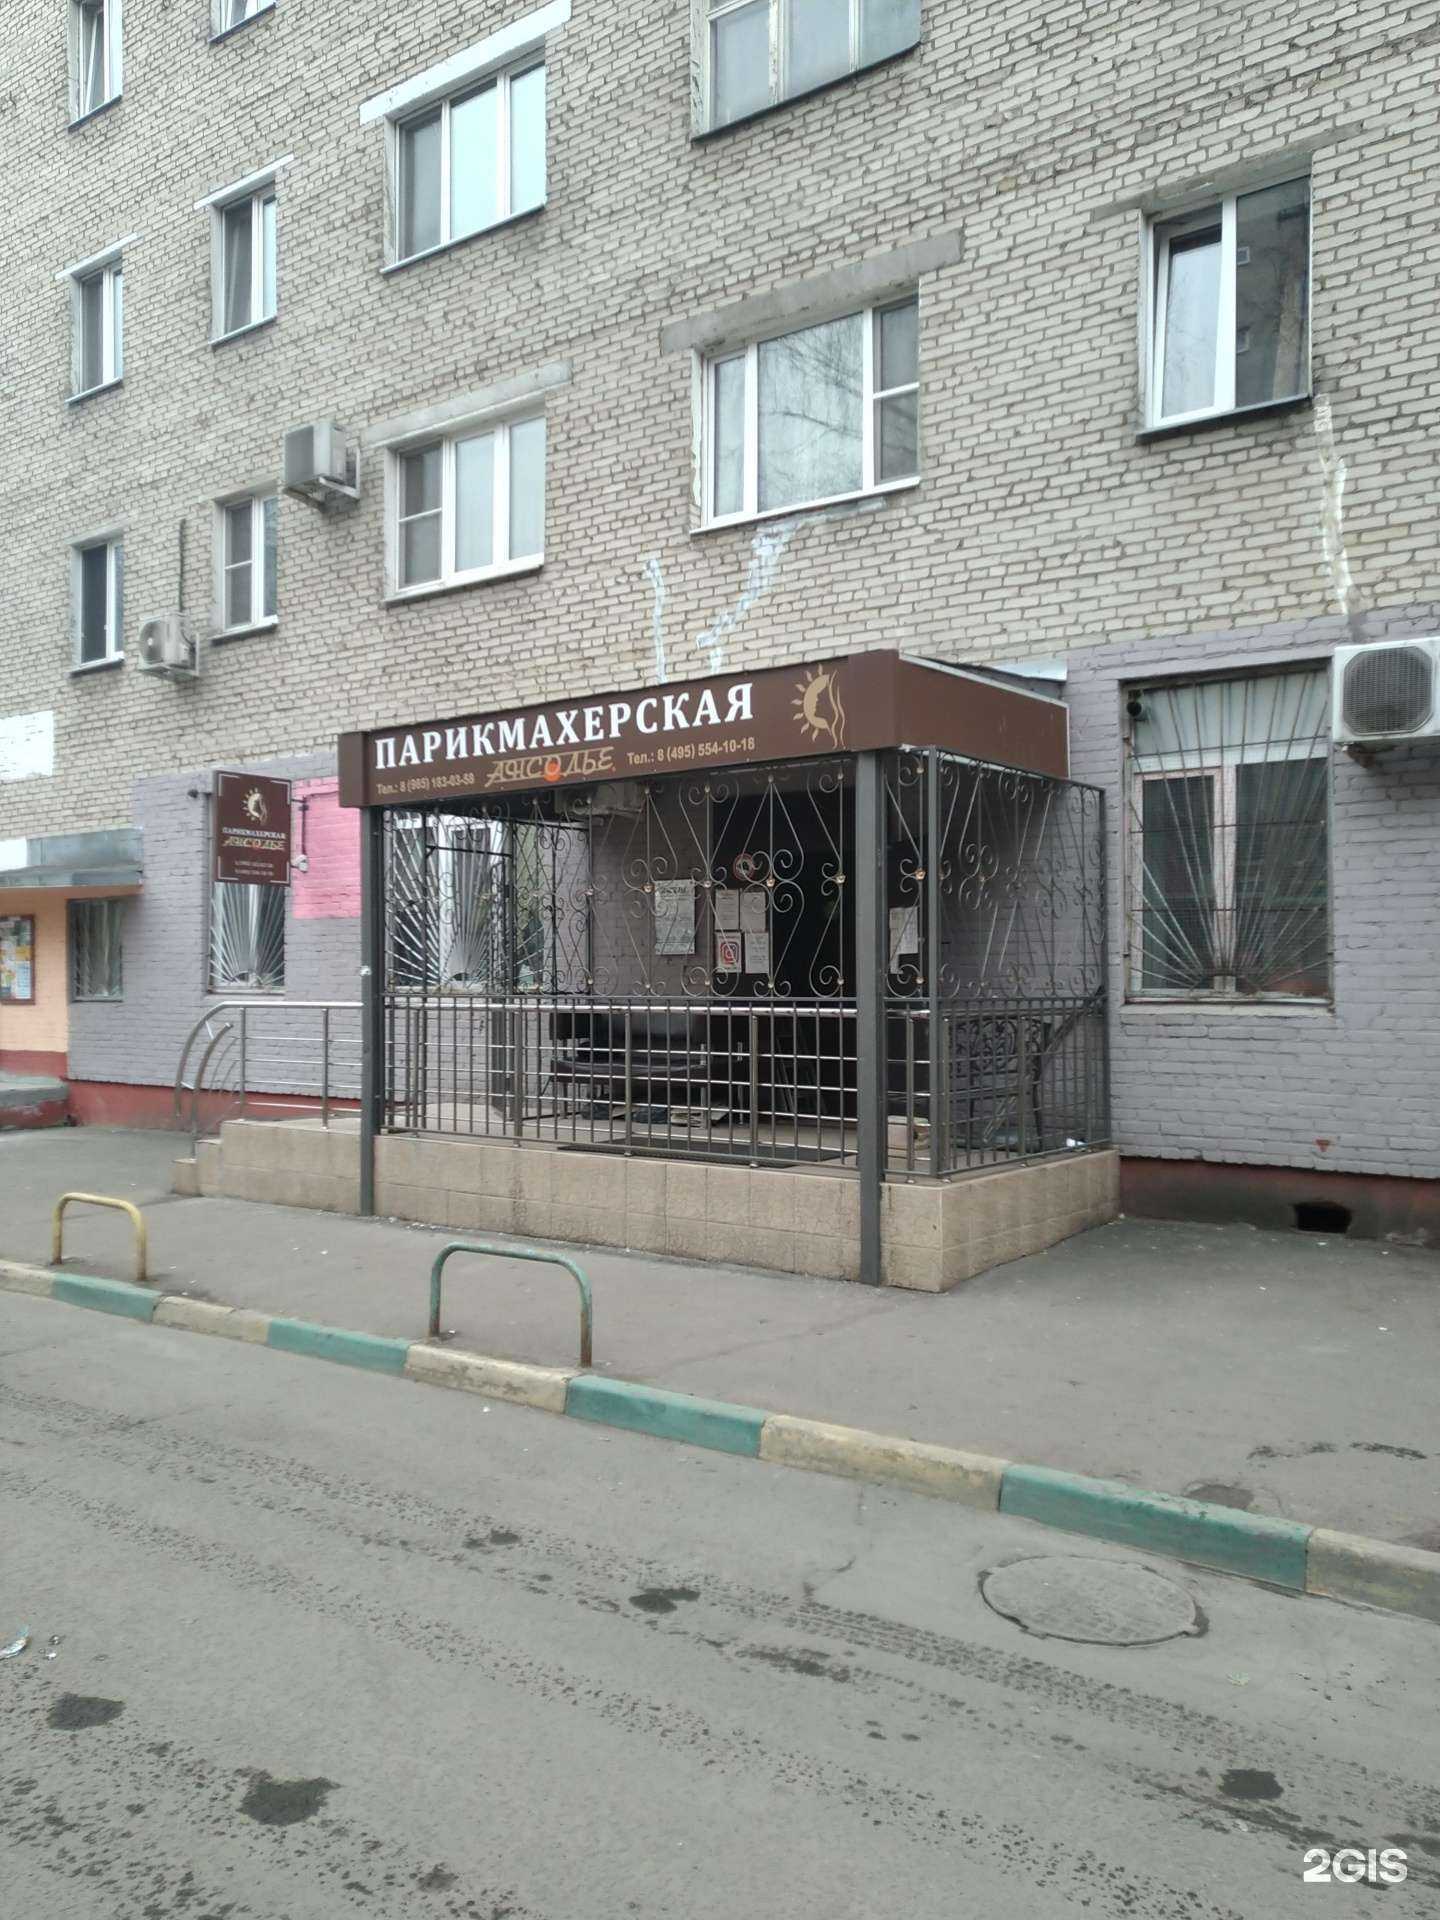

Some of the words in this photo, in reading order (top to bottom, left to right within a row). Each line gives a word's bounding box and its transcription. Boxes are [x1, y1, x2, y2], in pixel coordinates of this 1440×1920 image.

[376, 683, 754, 769] ПАРИКМАХЕРСКАЯ
[626, 751, 655, 765] Тел.:
[657, 748, 665, 762] 8
[666, 744, 695, 762] (495)
[698, 736, 756, 757] 554-10-18
